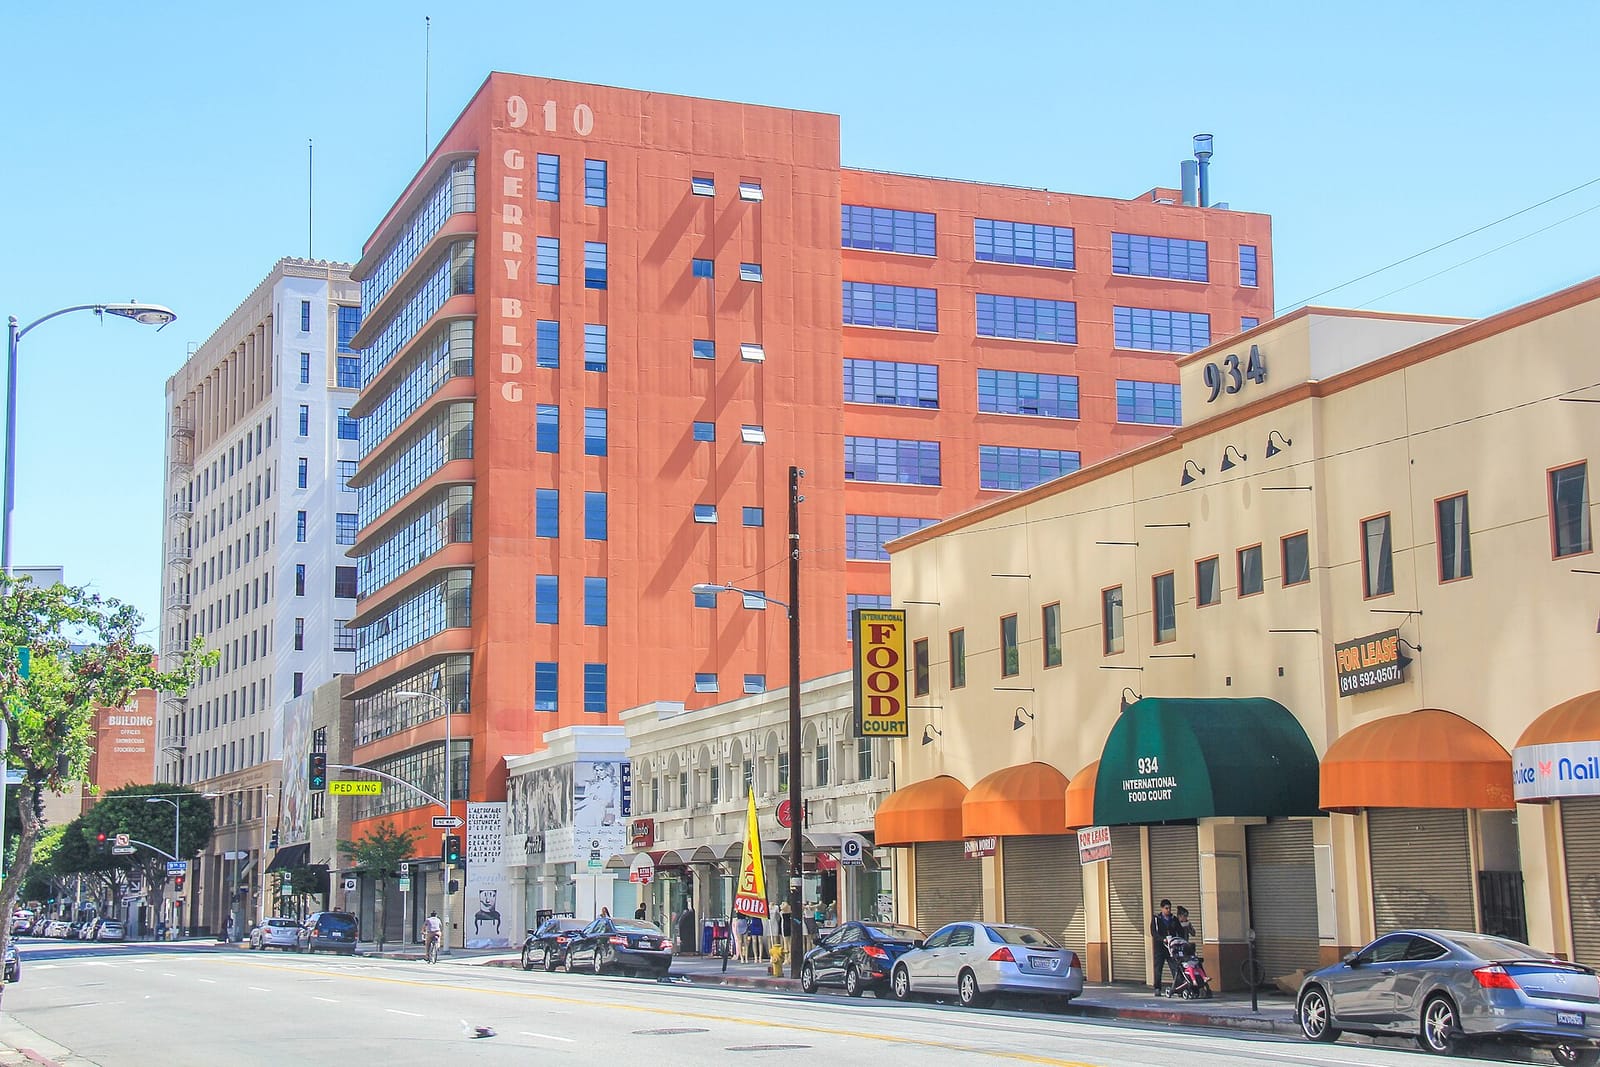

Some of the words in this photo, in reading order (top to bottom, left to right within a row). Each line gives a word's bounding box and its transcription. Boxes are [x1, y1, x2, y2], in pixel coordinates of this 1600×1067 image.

[506, 95, 594, 136] 910
[502, 149, 524, 280] GERRY
[501, 298, 523, 403] BLDG
[1203, 344, 1266, 403] 934
[862, 613, 903, 622] INTERNATIONAL
[1337, 647, 1360, 673] FOR
[1361, 636, 1397, 667] LEASE
[867, 623, 901, 717] FOOD
[108, 716, 153, 726] BUILDING
[863, 720, 905, 732] COURT
[1138, 757, 1158, 774] 934
[334, 784, 352, 792] PED
[356, 784, 377, 792] XING
[1122, 777, 1177, 790] INTERNATIONAL
[1128, 791, 1147, 802] FOOD
[1148, 789, 1172, 801] COURT
[1080, 832, 1092, 847] FOR
